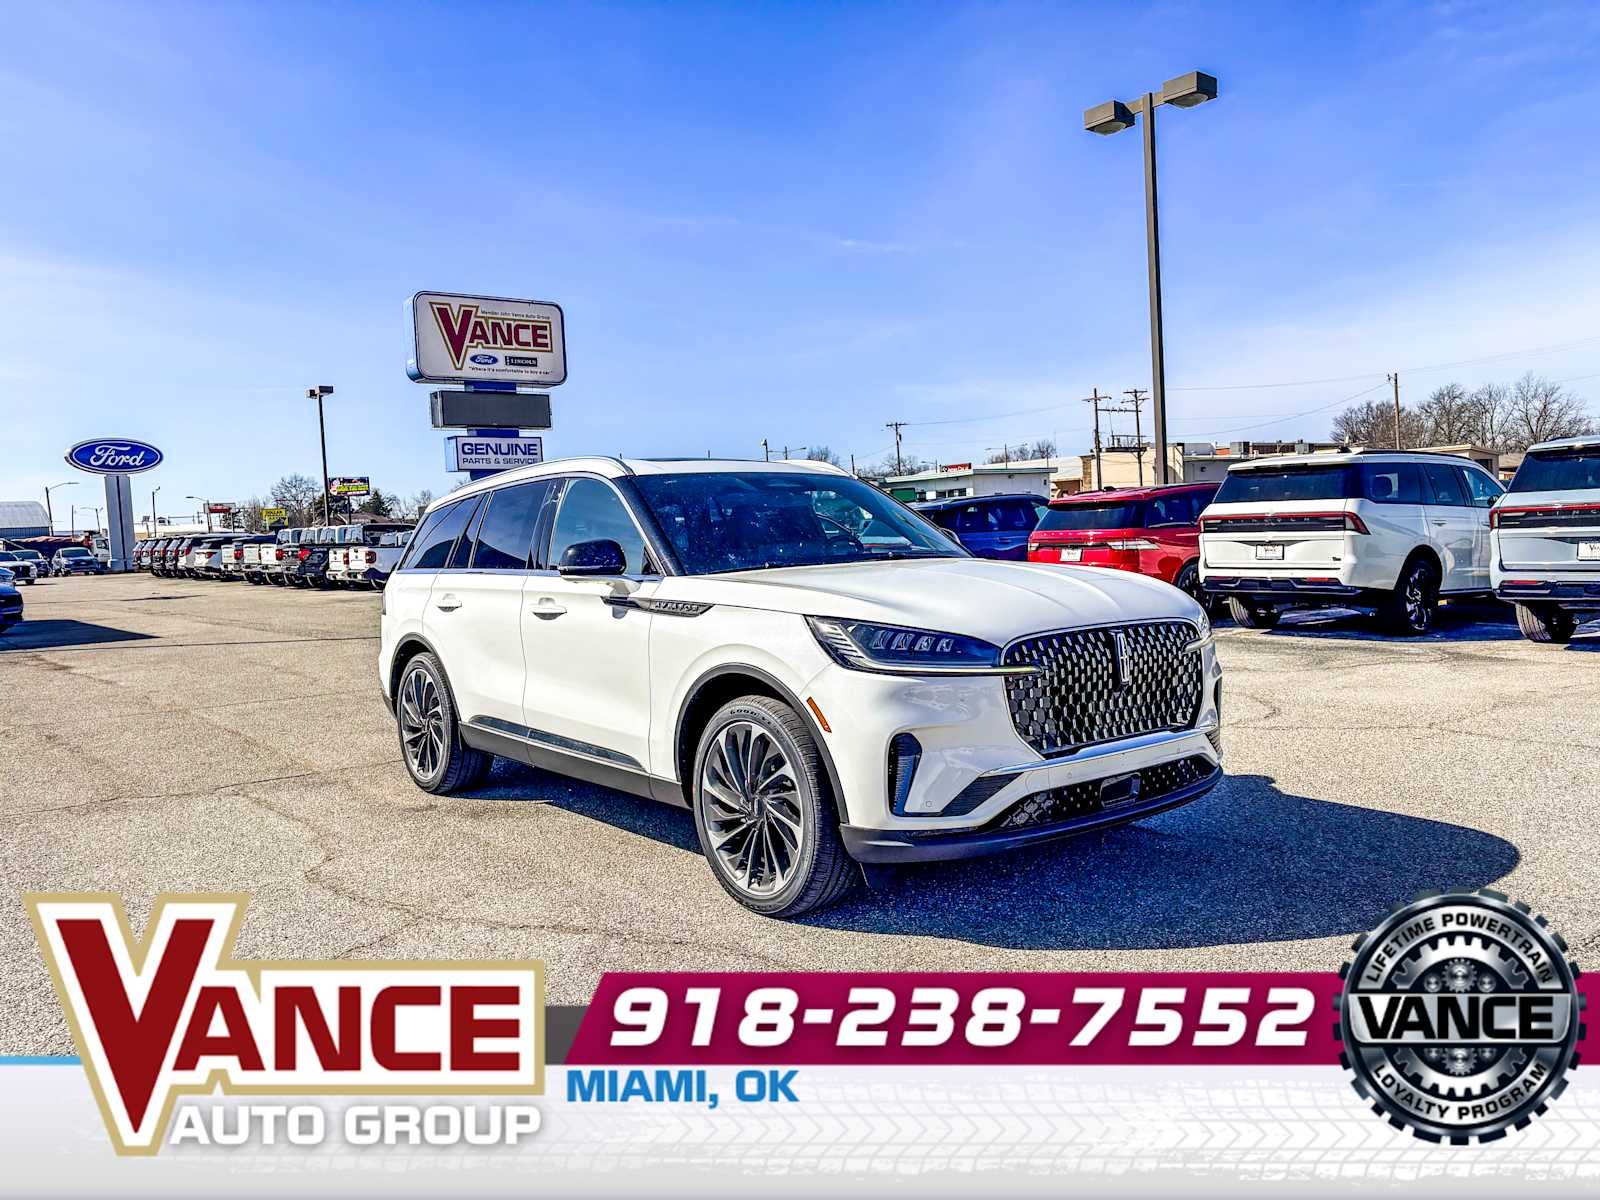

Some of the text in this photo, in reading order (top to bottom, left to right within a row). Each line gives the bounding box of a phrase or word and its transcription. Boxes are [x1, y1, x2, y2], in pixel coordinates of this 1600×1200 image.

[434, 306, 550, 367] VANCE
[475, 354, 493, 364] Ford
[90, 445, 145, 466] Ford
[461, 442, 538, 456] GENUINE
[655, 601, 700, 612] AVIATOR
